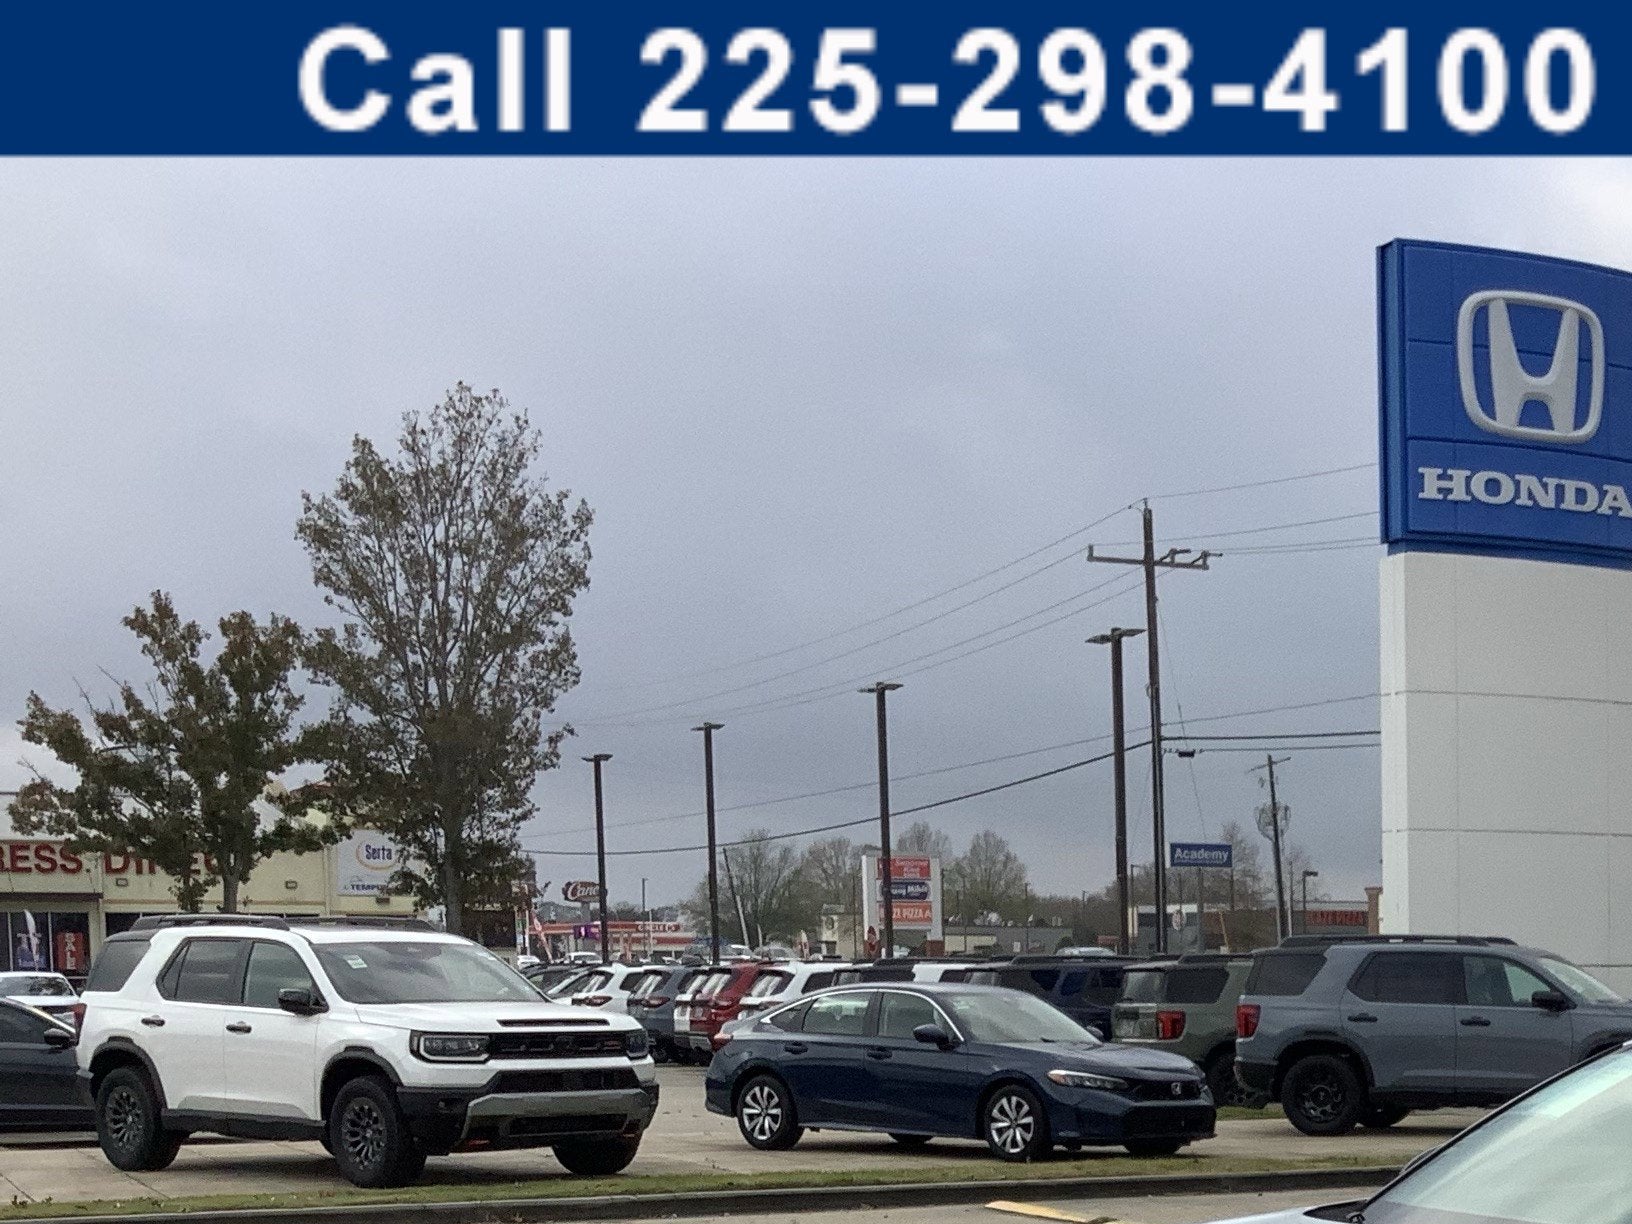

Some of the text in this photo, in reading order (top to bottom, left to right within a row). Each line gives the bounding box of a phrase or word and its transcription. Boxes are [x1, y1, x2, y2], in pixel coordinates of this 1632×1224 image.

[365, 844, 393, 861] Serta
[1174, 848, 1229, 864] Academy
[63, 931, 77, 970] SALE
